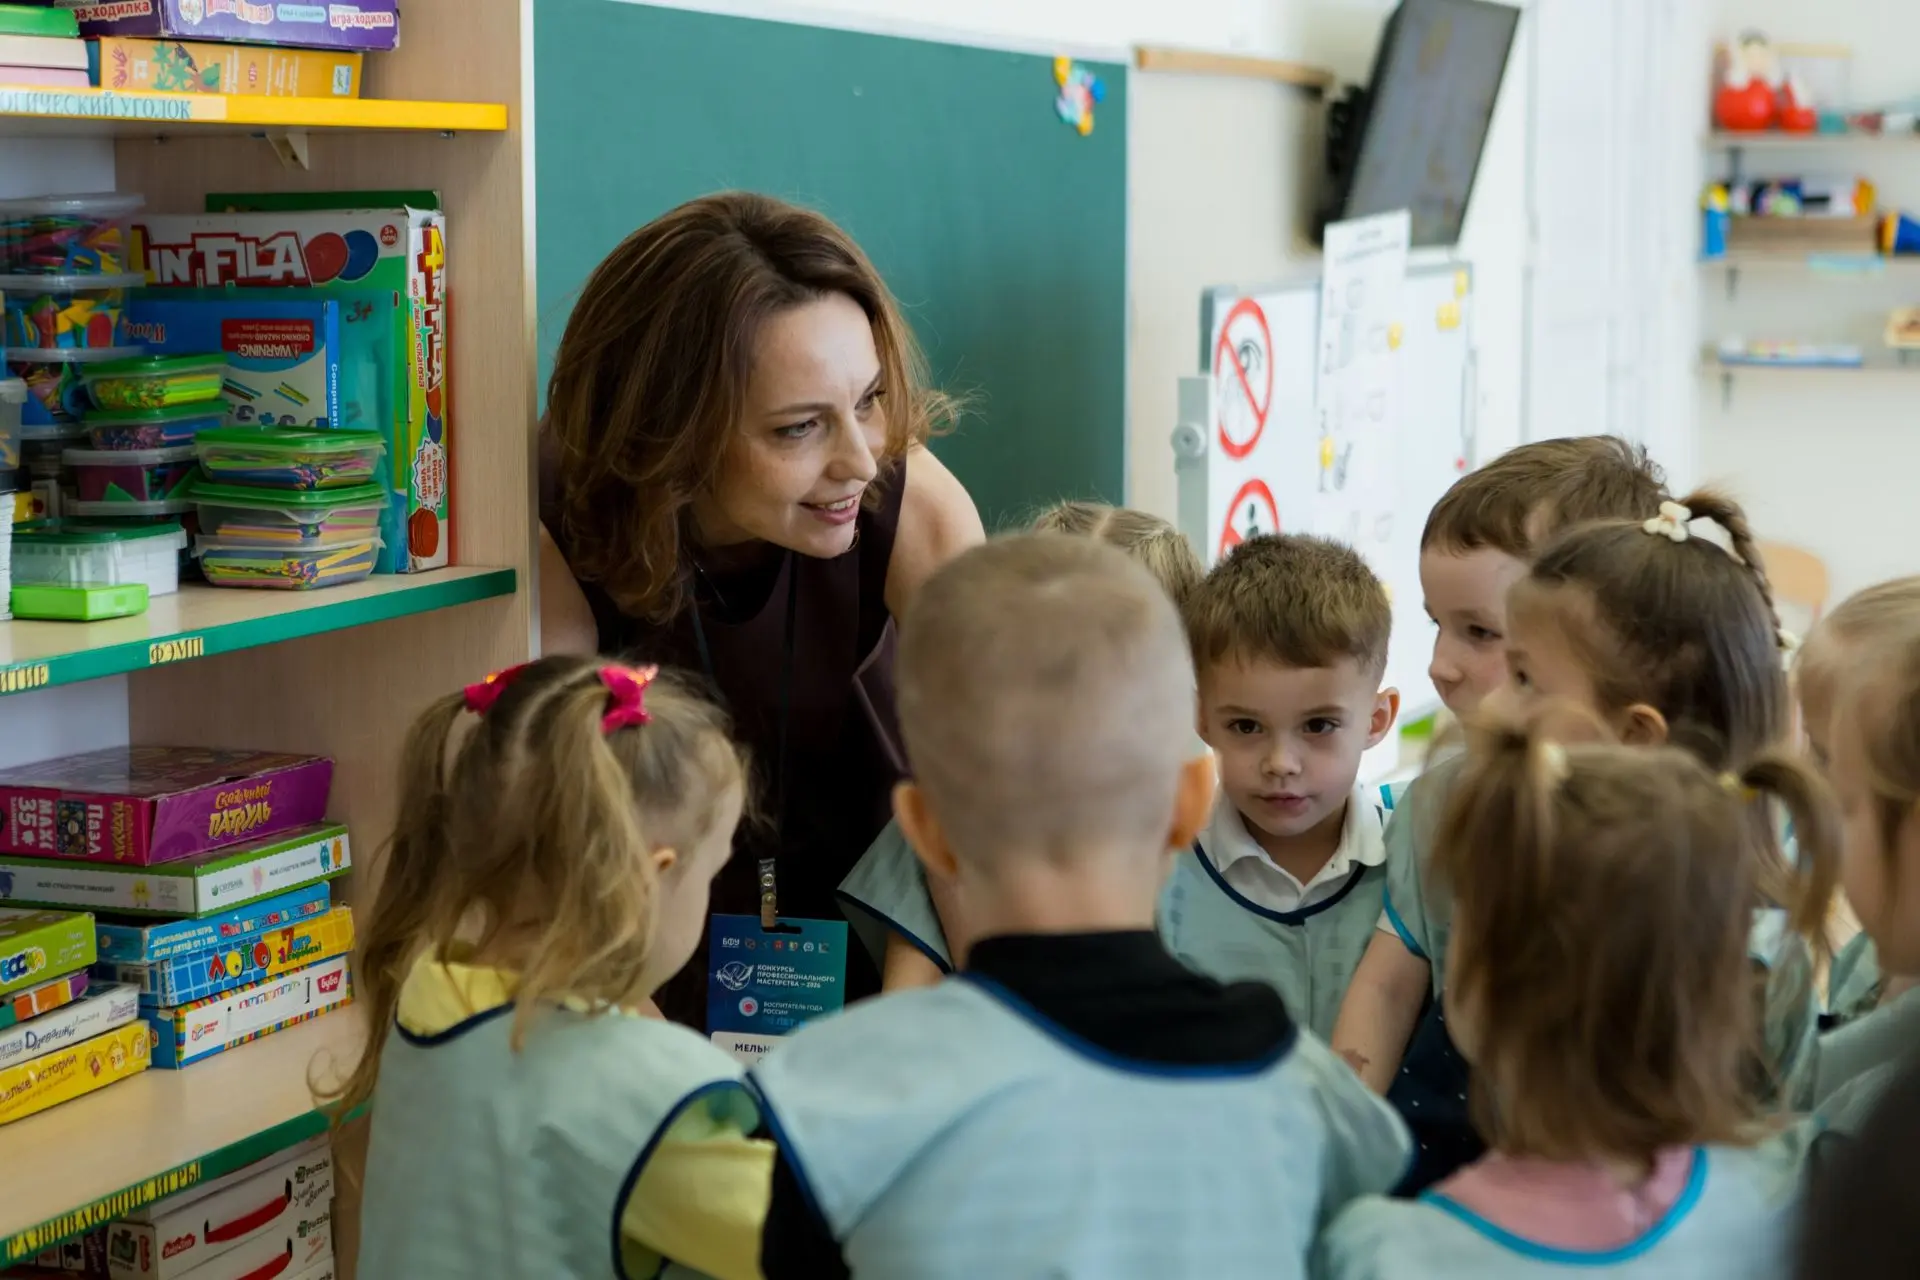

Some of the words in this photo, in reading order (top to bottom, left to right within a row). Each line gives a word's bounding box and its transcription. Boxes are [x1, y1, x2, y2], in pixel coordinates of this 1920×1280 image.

[331, 12, 394, 29] игра-ходилка
[120, 96, 191, 120] УГОЛОК
[194, 235, 307, 285] FILA
[425, 226, 444, 273] 4
[238, 343, 292, 358] WARNING:
[151, 637, 203, 664] ФЭМП
[215, 780, 272, 810] Сказочный
[18, 797, 38, 828] 35
[208, 801, 272, 838] ПАТРУЛЬ
[88, 804, 104, 854] Пазл
[281, 927, 295, 951] 7
[722, 937, 740, 946] БФУ
[208, 941, 271, 982] ЛОТО
[757, 964, 795, 972] КОНКУРСЫ
[756, 979, 800, 987] МАСТЕРСТВА
[757, 971, 836, 983] ПРОФЕССИОНАЛЬНОГО
[763, 1001, 806, 1010] ВОСПИТАТЕЛЬ
[734, 1043, 774, 1053] МЕЛЬН
[35, 1053, 77, 1083] истории
[8, 1184, 154, 1260] РАЗВИВАЮЩИЕ
[155, 1161, 200, 1197] ИГРЫ
